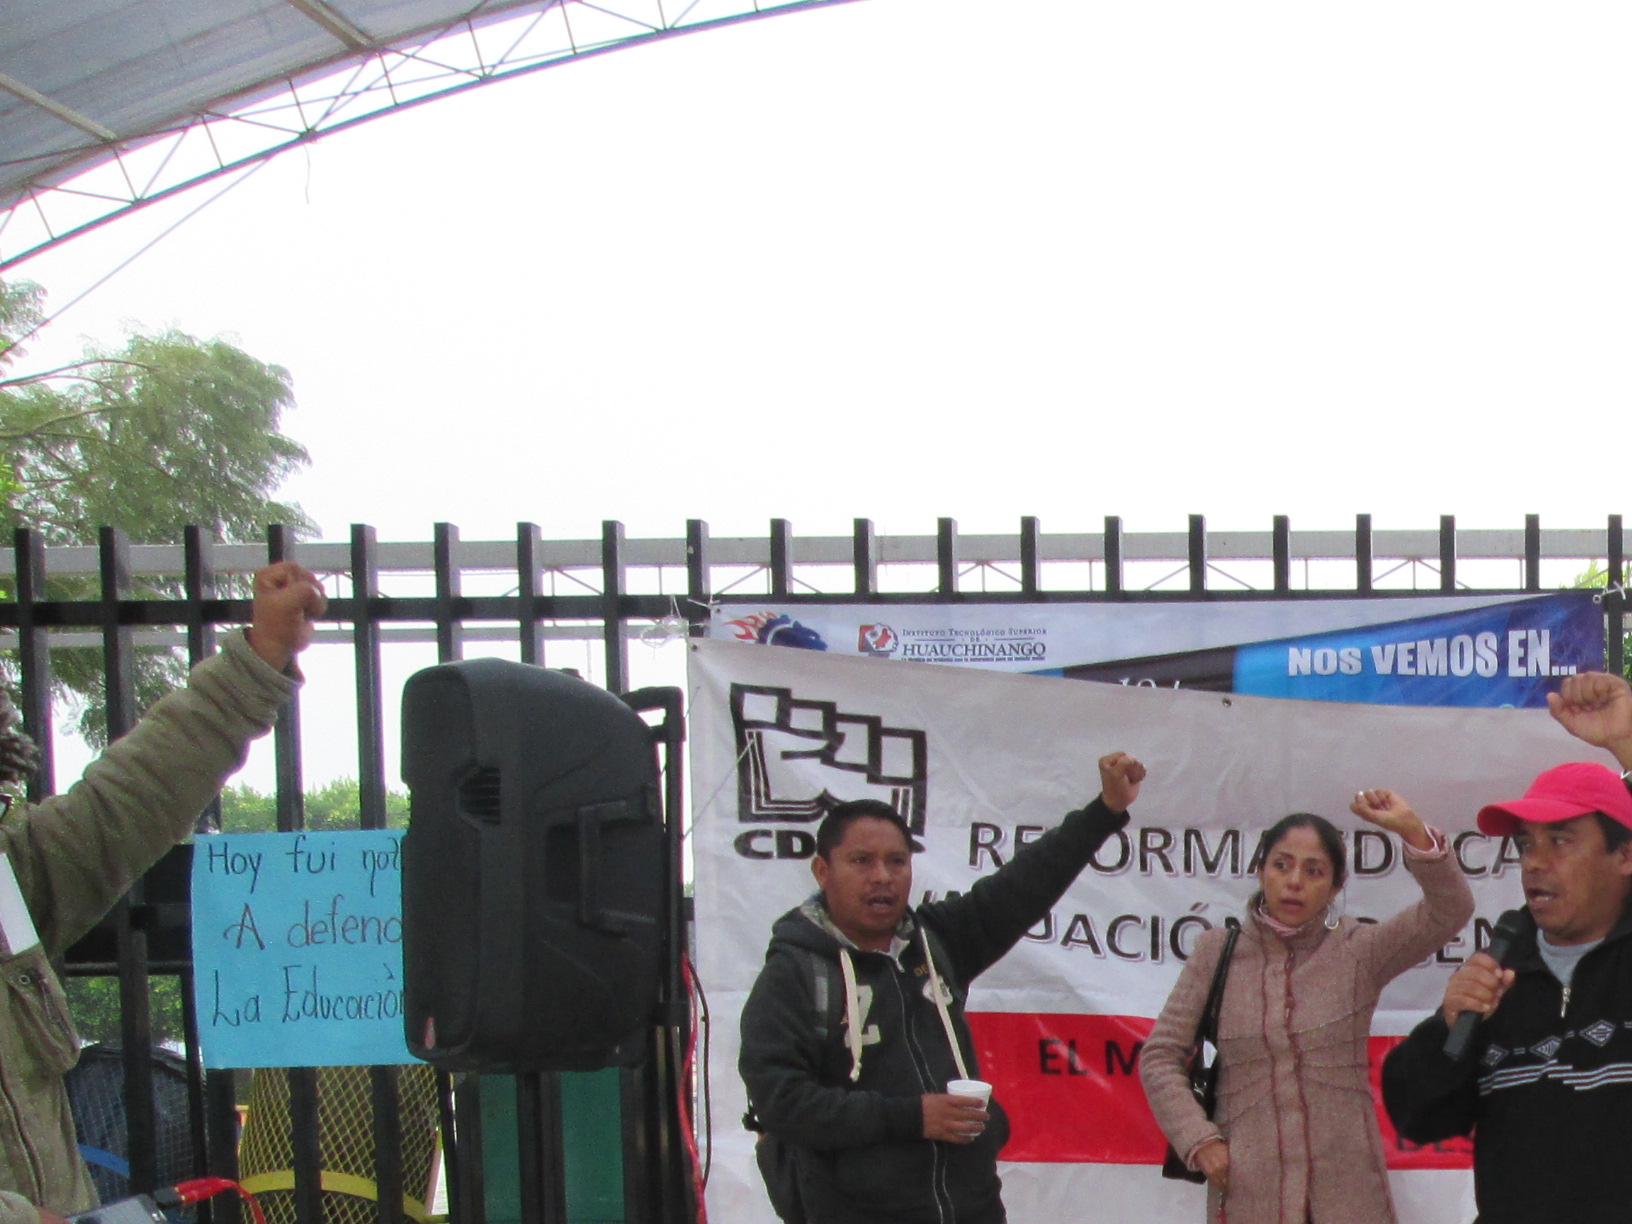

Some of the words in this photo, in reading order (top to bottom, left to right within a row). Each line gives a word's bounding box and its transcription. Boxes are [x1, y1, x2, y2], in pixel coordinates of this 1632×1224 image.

[902, 642, 1047, 657] HUAUCHINANGO
[1288, 646, 1363, 677] NOS
[1371, 632, 1499, 676] VEMOS
[1508, 629, 1579, 677] EN...
[208, 842, 263, 895] Hoy
[286, 835, 337, 874] fui
[222, 902, 266, 951] A
[212, 969, 261, 1027] La
[1039, 1039, 1088, 1076] EL
